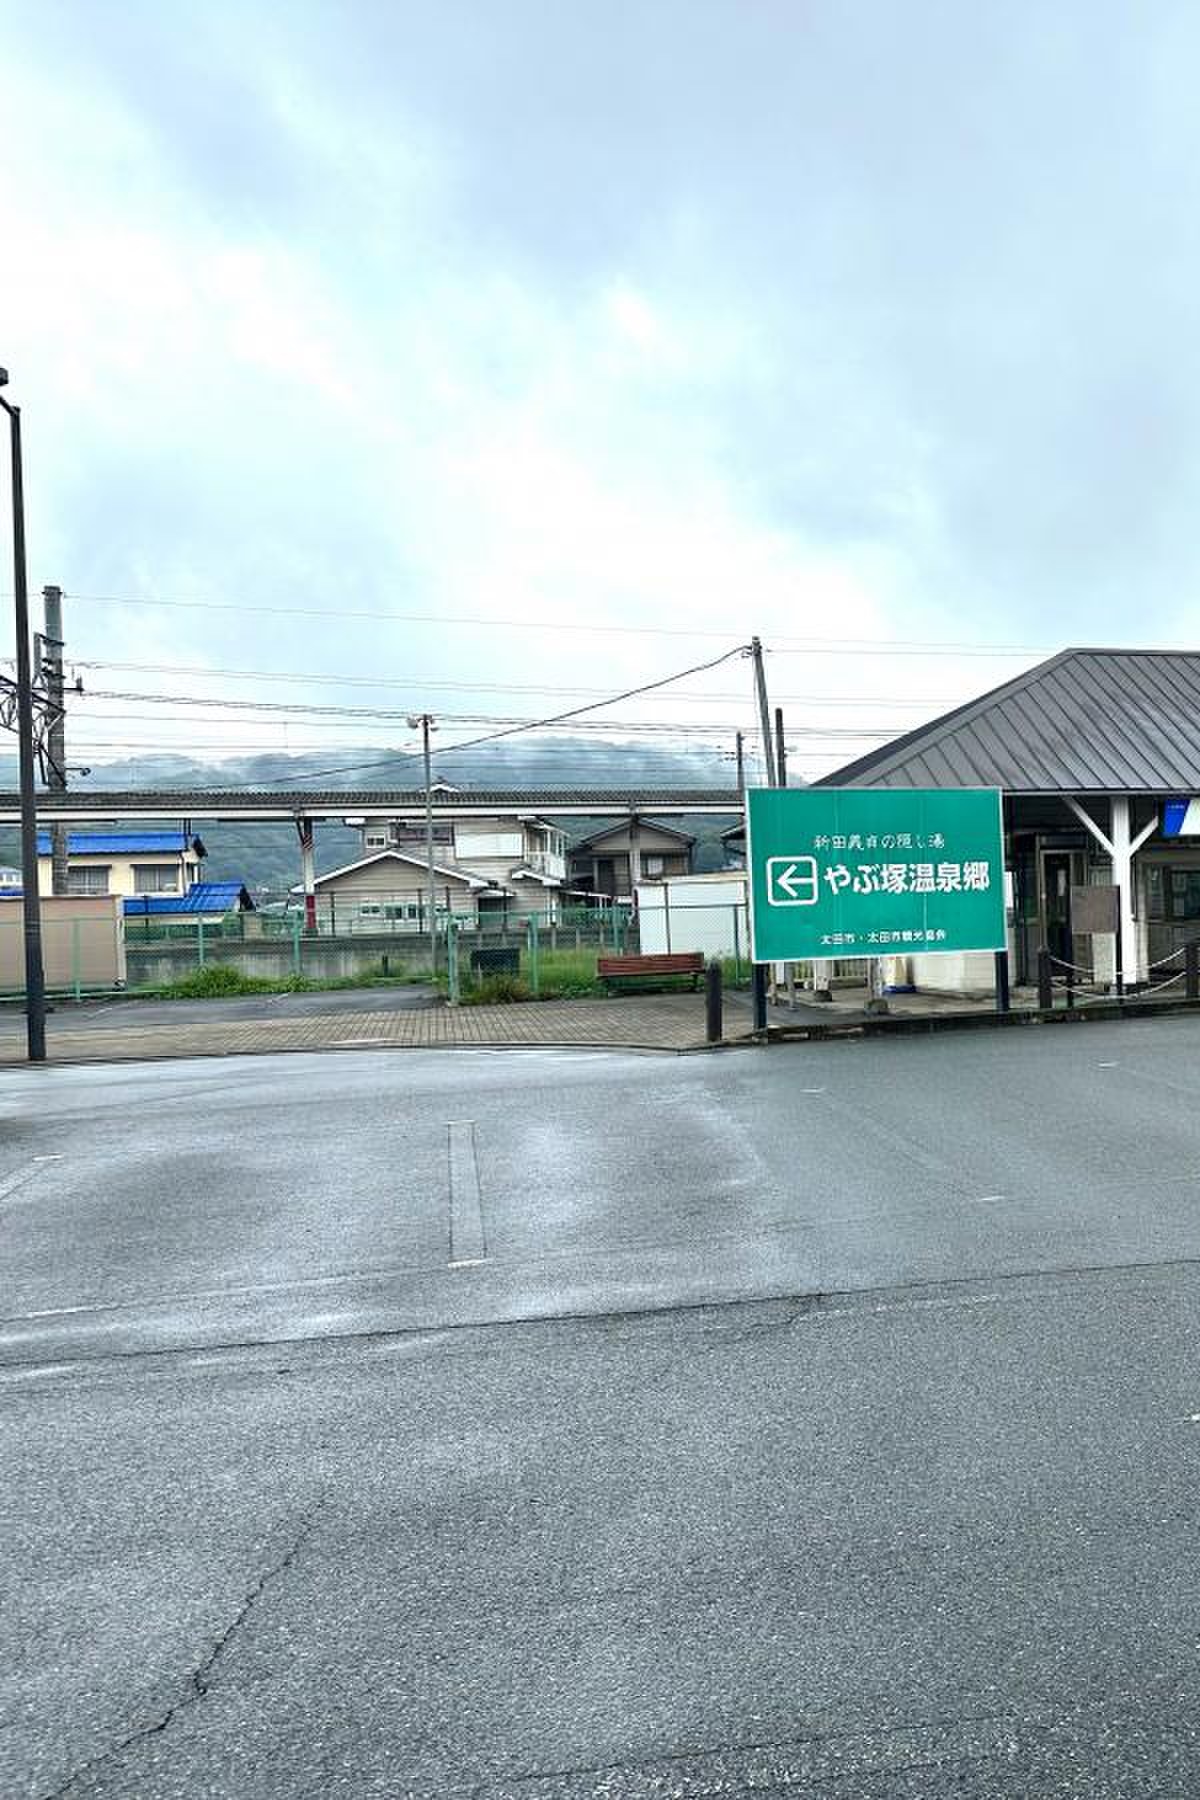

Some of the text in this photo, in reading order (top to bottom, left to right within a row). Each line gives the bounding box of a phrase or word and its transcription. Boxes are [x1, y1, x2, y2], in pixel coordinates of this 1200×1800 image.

[824, 862, 990, 894] やぶ塚温泉郷
